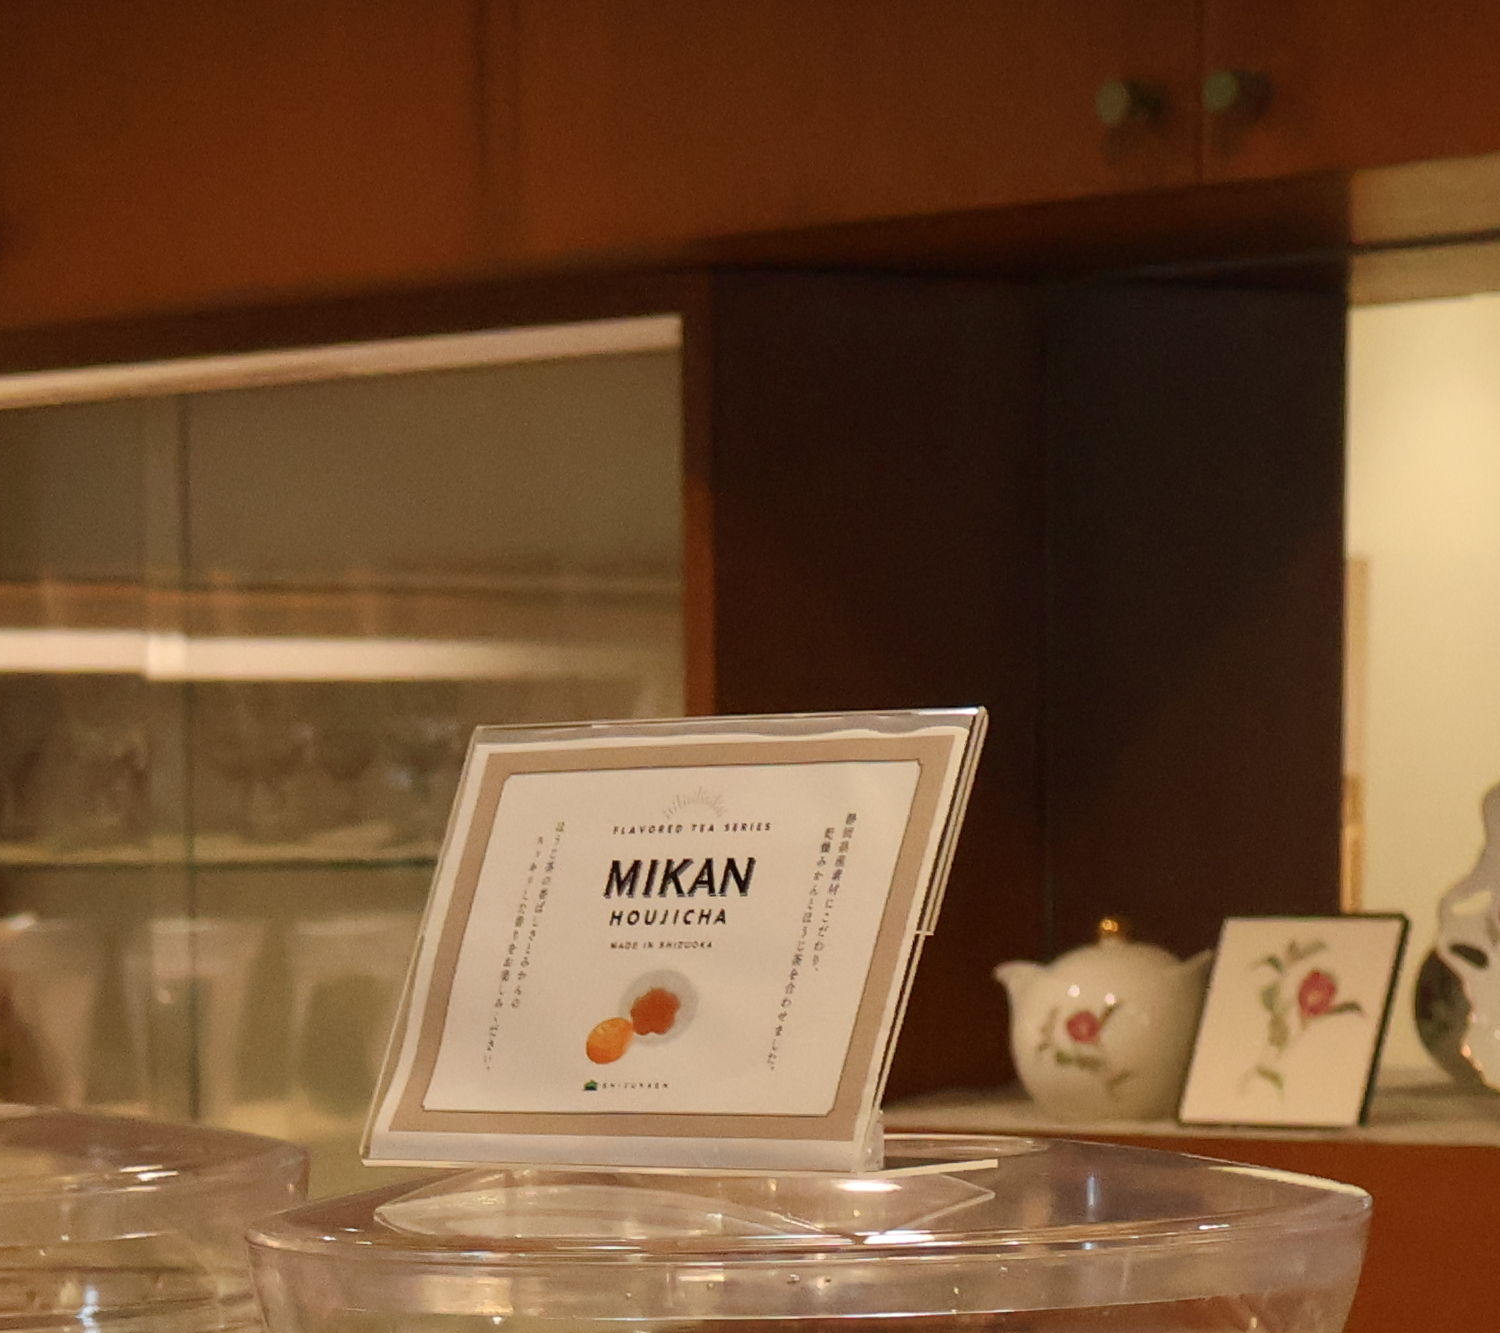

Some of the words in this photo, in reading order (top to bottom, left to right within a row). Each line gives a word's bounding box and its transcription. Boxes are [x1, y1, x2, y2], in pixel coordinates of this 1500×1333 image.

[612, 824, 684, 835] FLAVORED
[691, 823, 715, 833] TEA
[723, 822, 772, 833] SERIES
[603, 857, 757, 899] MIKAN
[609, 908, 727, 926] HOUJICHA
[610, 941, 638, 950] MADE
[643, 941, 654, 949] IN
